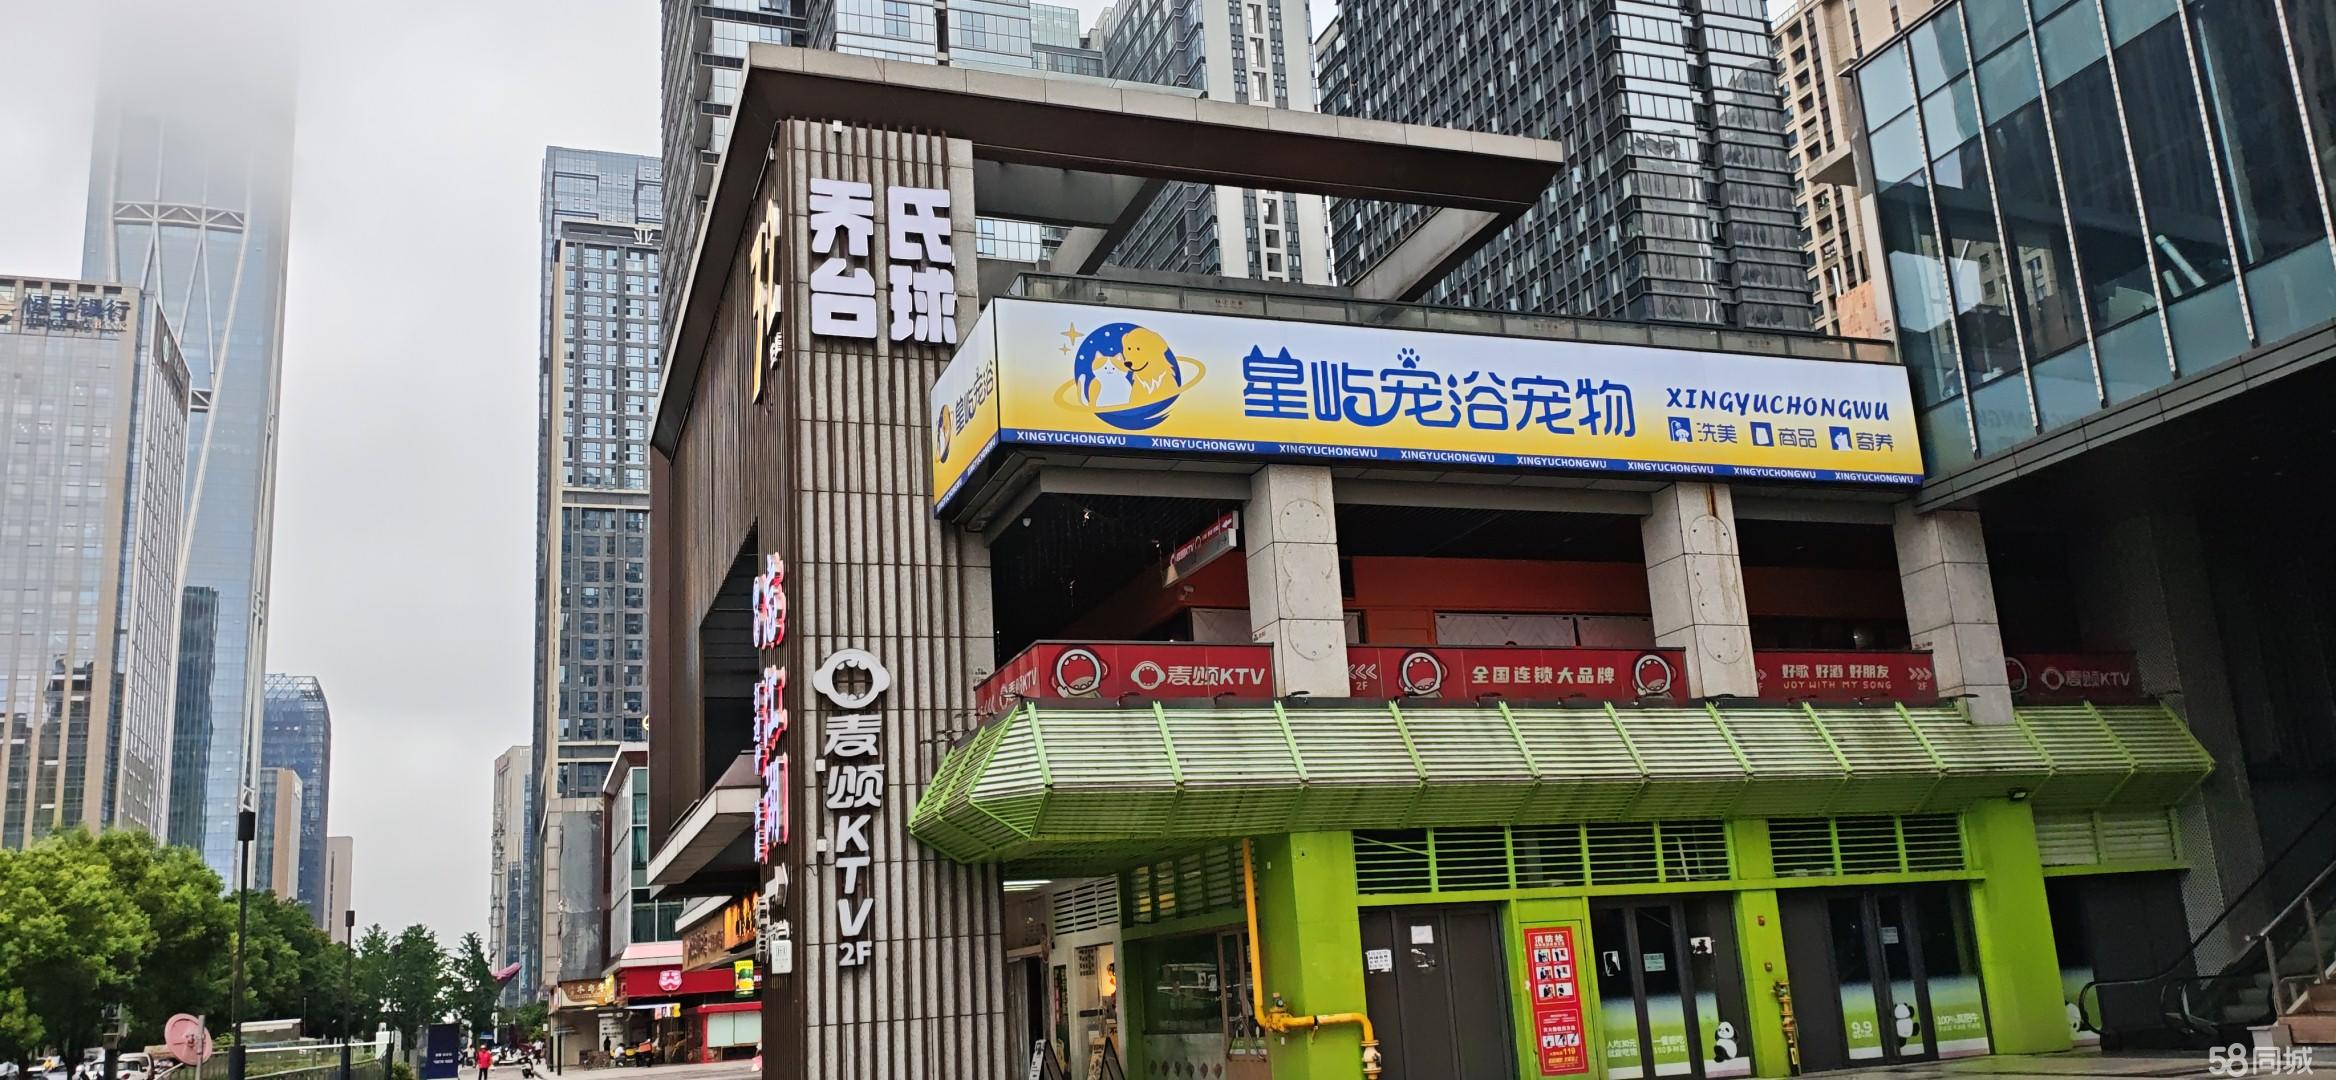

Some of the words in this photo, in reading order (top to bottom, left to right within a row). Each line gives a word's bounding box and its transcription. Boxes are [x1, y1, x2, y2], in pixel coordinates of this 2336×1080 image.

[810, 178, 954, 264] 乔氏
[810, 257, 957, 344] 台球
[1243, 344, 1636, 438] 星屿宠浴宠物
[1667, 387, 1890, 421] XINGYUCHONGWU
[1696, 421, 1738, 444] 洗美
[1777, 427, 1818, 449] 商品
[1856, 431, 1894, 453] 寄养
[1017, 431, 1126, 446] XINGYUCHONGWU
[1151, 436, 1255, 453] XINGYUCHONGWU
[1279, 443, 1378, 458] XINGYUCHONGWU
[1401, 450, 1495, 464] XINGYUCHONGWU
[1517, 456, 1607, 469] XINGYUCHONGWU
[1628, 461, 1714, 475] XINGYUCHONGWU
[1734, 466, 1817, 480] XINGYUCHONGWU
[1835, 471, 1914, 485] XINGYUCHONGWU
[1167, 665, 1265, 687] 麦颂KTV
[1355, 680, 1369, 691] 2F
[1471, 665, 1616, 685] 全国连锁大品牌
[1782, 664, 1809, 679] 好歌
[1815, 664, 1843, 679] 好酒
[1849, 664, 1889, 679] 好朋友
[1783, 680, 1805, 689] JOY
[1809, 680, 1836, 689] WITH
[1842, 680, 1858, 689] MY
[1863, 680, 1892, 690] SONG
[824, 713, 885, 937] 麦颂KTV
[838, 940, 873, 967] 2F
[1851, 1020, 1873, 1034] 9.9
